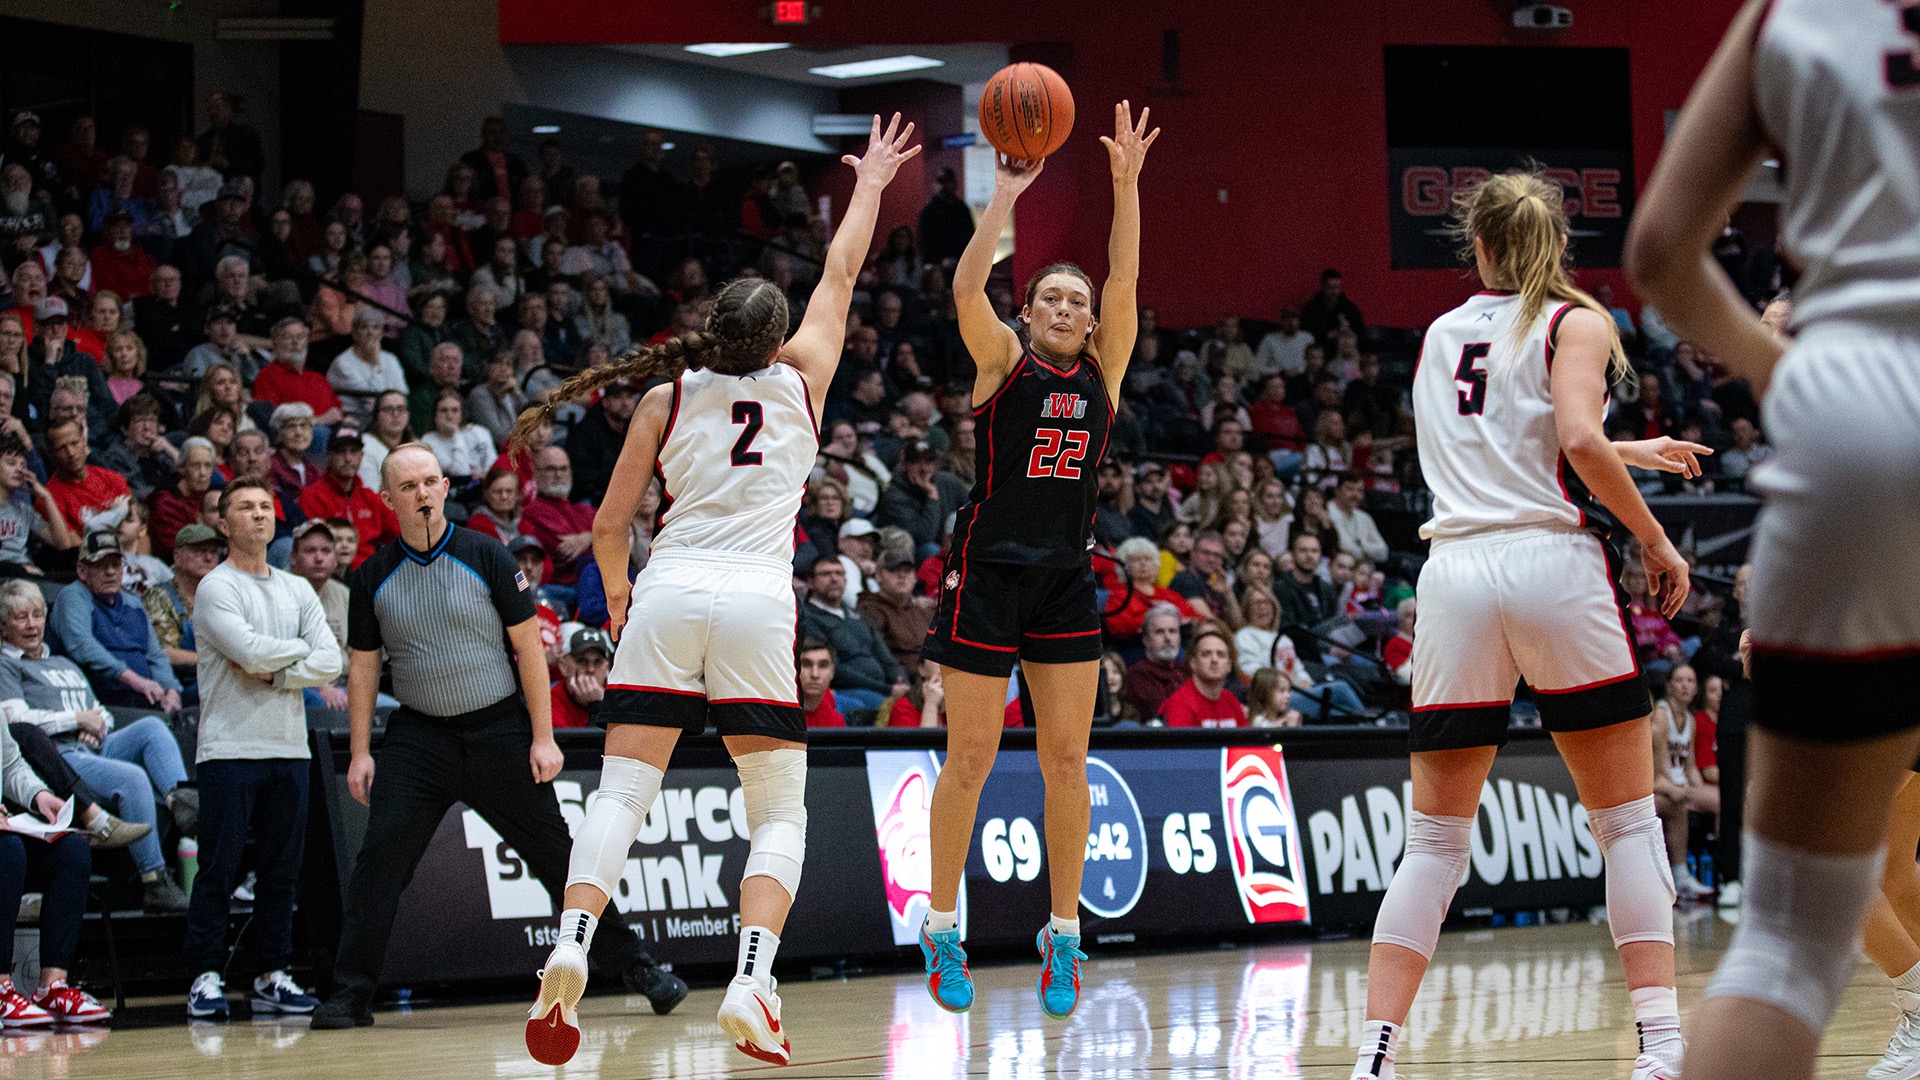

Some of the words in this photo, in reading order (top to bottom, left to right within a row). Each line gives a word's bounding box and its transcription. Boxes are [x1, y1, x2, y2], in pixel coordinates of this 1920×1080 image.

[1454, 342, 1492, 417] 5
[731, 400, 764, 467] 2
[1027, 428, 1090, 480] 22
[1089, 784, 1109, 807] TH
[981, 816, 1041, 883] 69
[1162, 812, 1217, 875] 65
[1308, 780, 1413, 895] PAP
[1459, 778, 1604, 888] OHNS
[612, 845, 728, 915] ank
[1103, 876, 1117, 900] 4
[667, 914, 728, 939] Member
